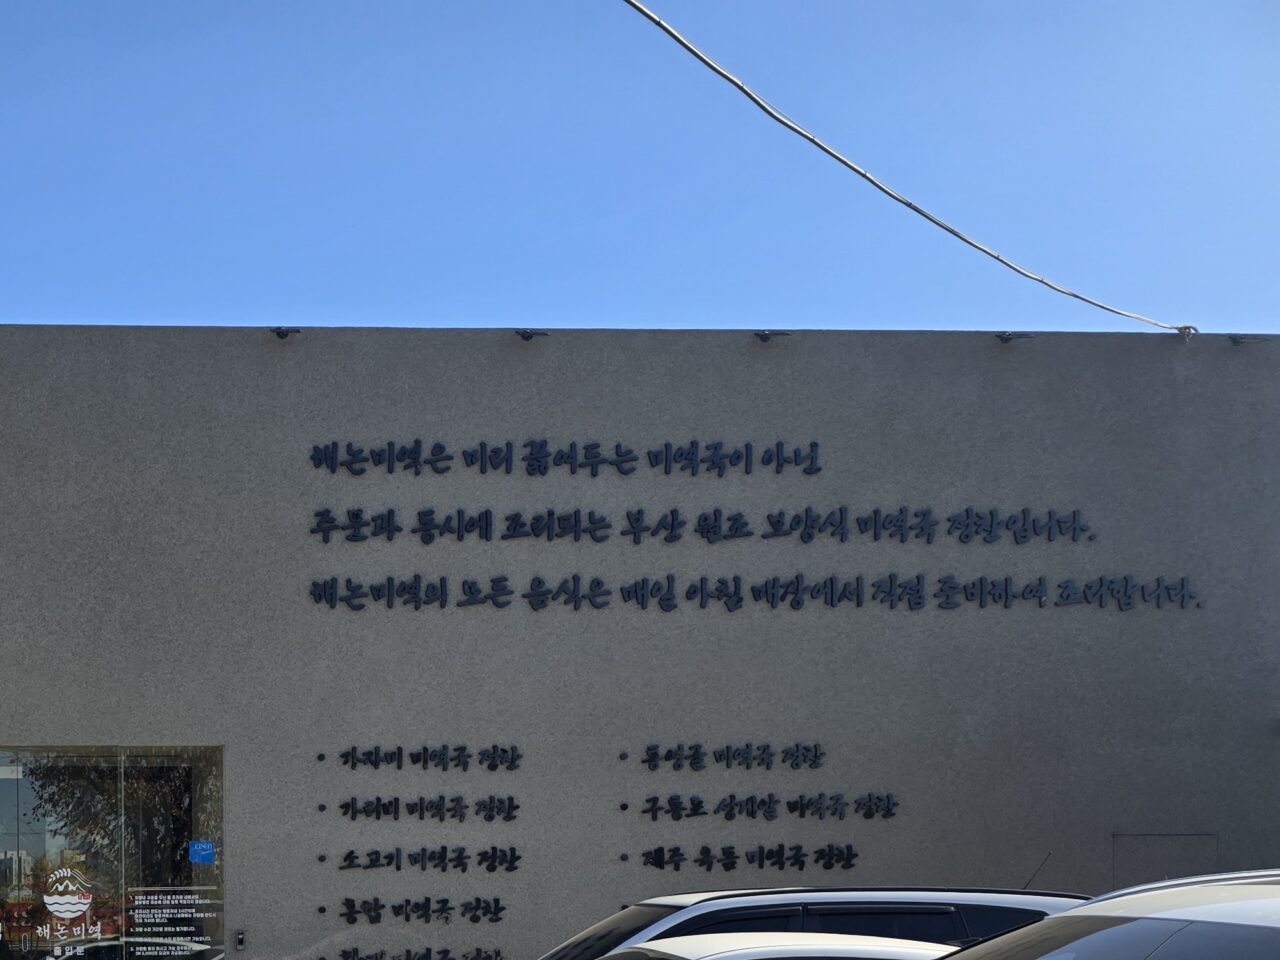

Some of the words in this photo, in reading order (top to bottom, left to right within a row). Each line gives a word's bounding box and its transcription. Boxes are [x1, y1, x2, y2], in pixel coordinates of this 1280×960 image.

[309, 438, 455, 477] 해논미역은
[461, 440, 514, 475] 미리
[520, 438, 640, 479] 끓여두는
[646, 439, 754, 479] 미역국이
[760, 440, 823, 477] 아닌
[309, 507, 404, 545] 주문과
[410, 508, 493, 546] 동시에
[500, 508, 613, 544] 조리되는
[619, 508, 687, 546] 부산
[693, 507, 755, 545] 원조
[760, 505, 850, 545] 보양식
[855, 506, 940, 545] 미역국
[945, 507, 1097, 546] 정찬입니다.
[308, 573, 449, 612] 해논미역의
[455, 575, 515, 610] 모든
[520, 573, 613, 613] 음식은
[619, 574, 678, 613] 매일
[684, 575, 745, 614] 아침
[749, 573, 865, 611] 매장에서
[870, 572, 926, 612] 직접
[932, 575, 1047, 611] 준비하여
[339, 745, 404, 771] 가자미
[408, 744, 473, 772] 미역국
[477, 744, 523, 772] 정찬
[640, 743, 707, 772] 통영굴
[712, 742, 777, 771] 미역국
[781, 742, 826, 771] 정찬
[404, 794, 470, 823] 미역국
[474, 795, 521, 823] 정찬
[641, 794, 709, 822] 구룡포
[713, 792, 781, 822] 성게알
[785, 792, 850, 821] 미역국
[853, 792, 900, 820] 정찬
[338, 847, 402, 872] 소고기
[407, 845, 471, 874] 미역국
[476, 845, 522, 873] 정찬
[641, 846, 687, 872] 제주
[693, 845, 740, 873] 옥돔
[745, 843, 809, 872] 미역국
[813, 843, 859, 871] 정찬
[338, 897, 386, 925] 홍합
[390, 896, 456, 924] 미역국
[460, 896, 507, 924] 정찬
[36, 922, 102, 940] 해논미역
[53, 946, 85, 957] 출입문
